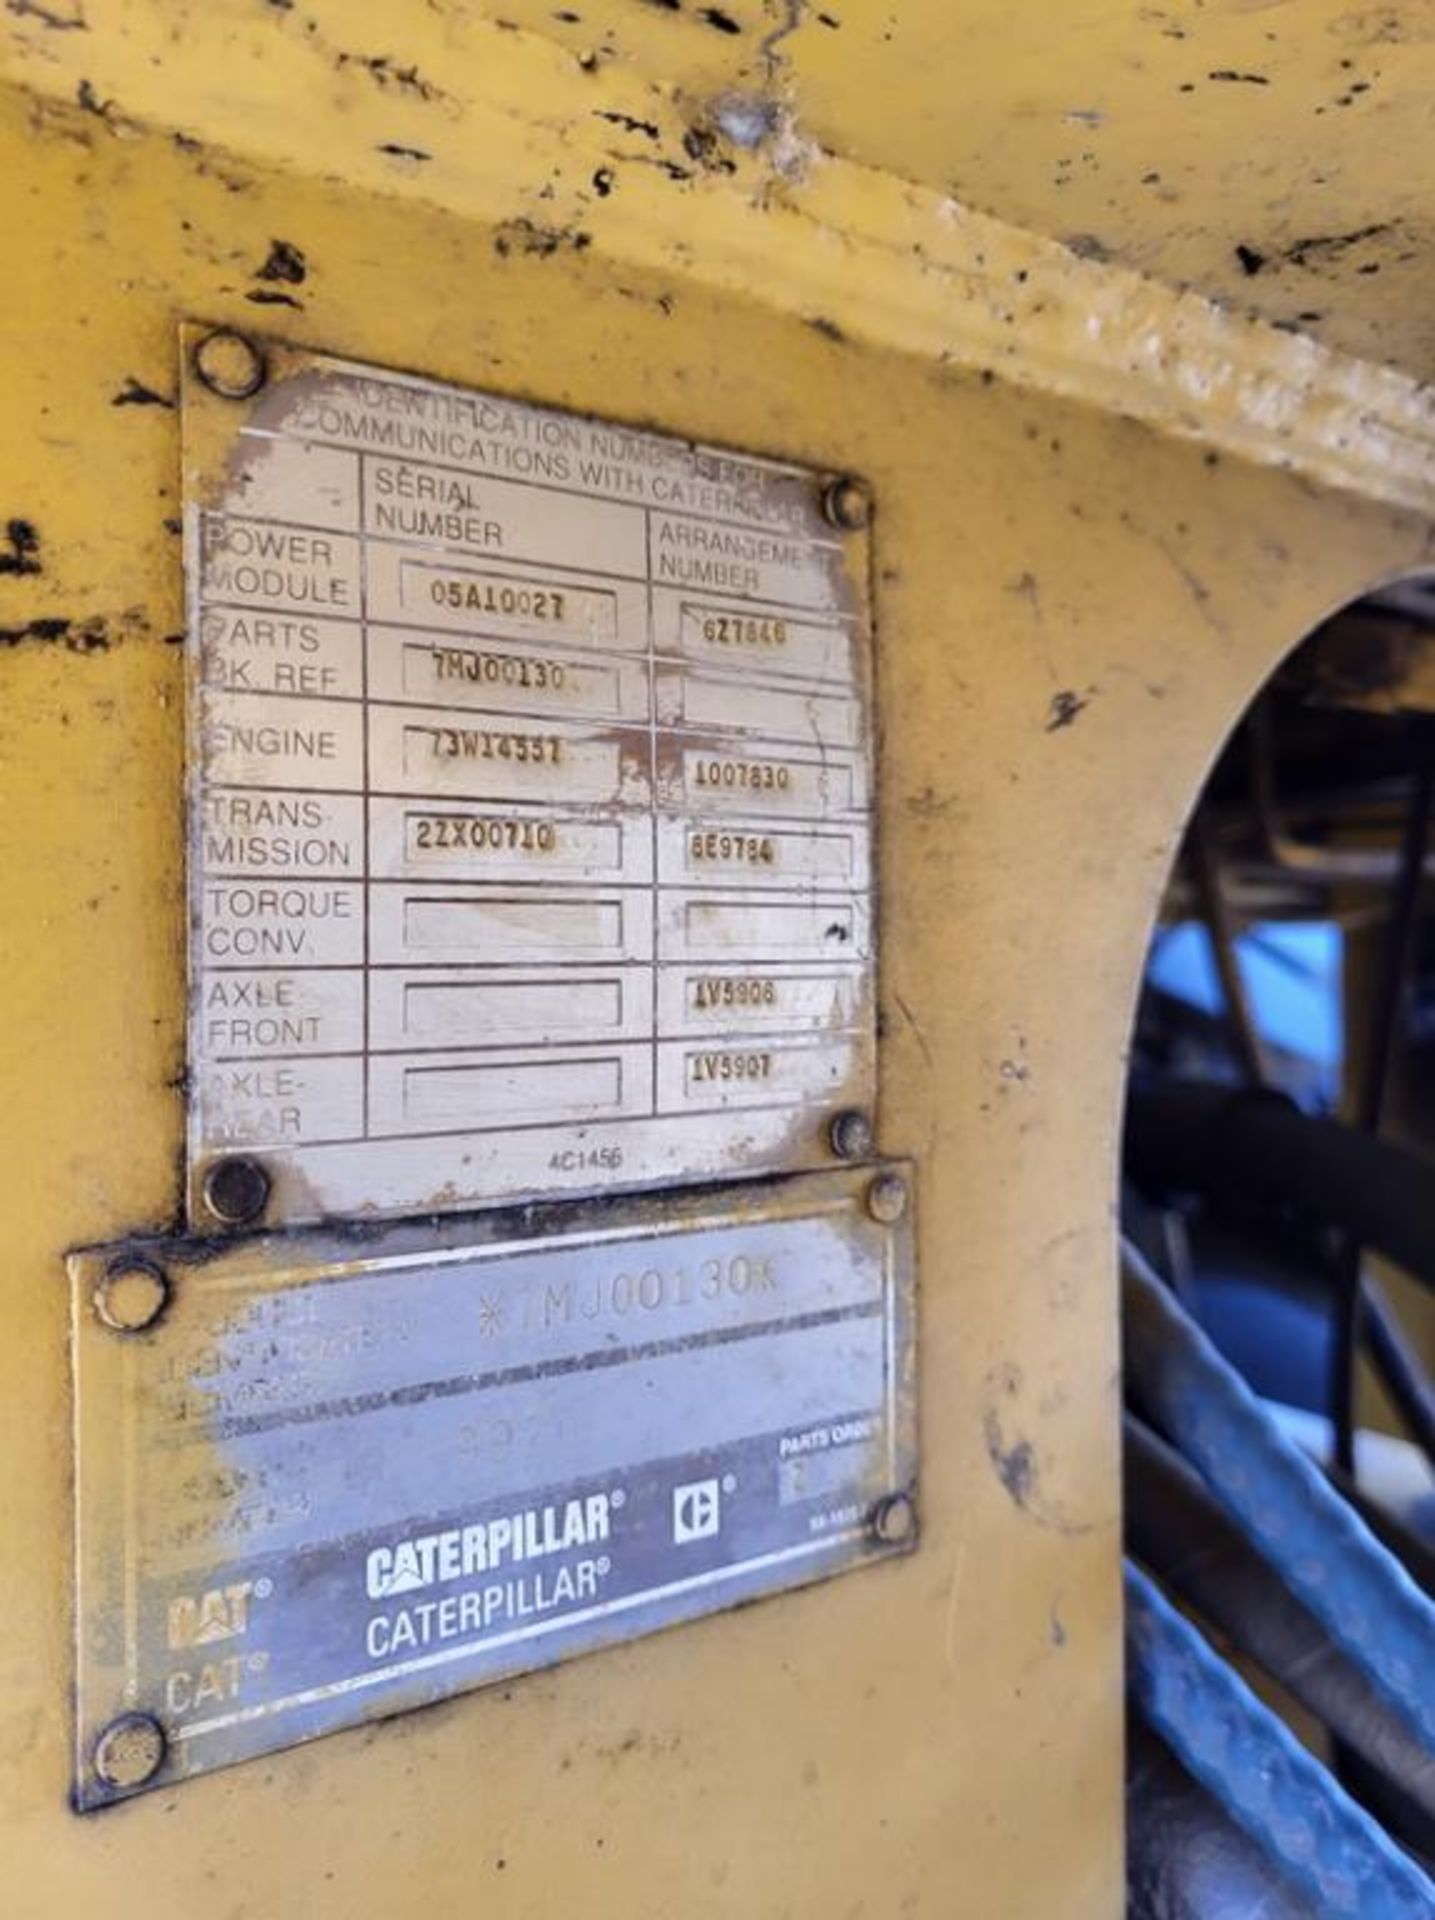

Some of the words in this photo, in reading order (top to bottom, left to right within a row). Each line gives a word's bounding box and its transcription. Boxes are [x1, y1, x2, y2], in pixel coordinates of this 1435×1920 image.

[375, 466, 480, 511] SERIAL
[579, 461, 644, 496] WITH
[376, 503, 502, 545] NUMBER
[659, 522, 826, 576] ARRANGEME
[659, 553, 760, 590] NUMBER
[433, 652, 564, 691] 7MJ00130
[206, 837, 350, 867] MISSION
[208, 888, 352, 920] TORQUE
[207, 1017, 321, 1047] FRONT
[779, 1429, 830, 1458] PARTS
